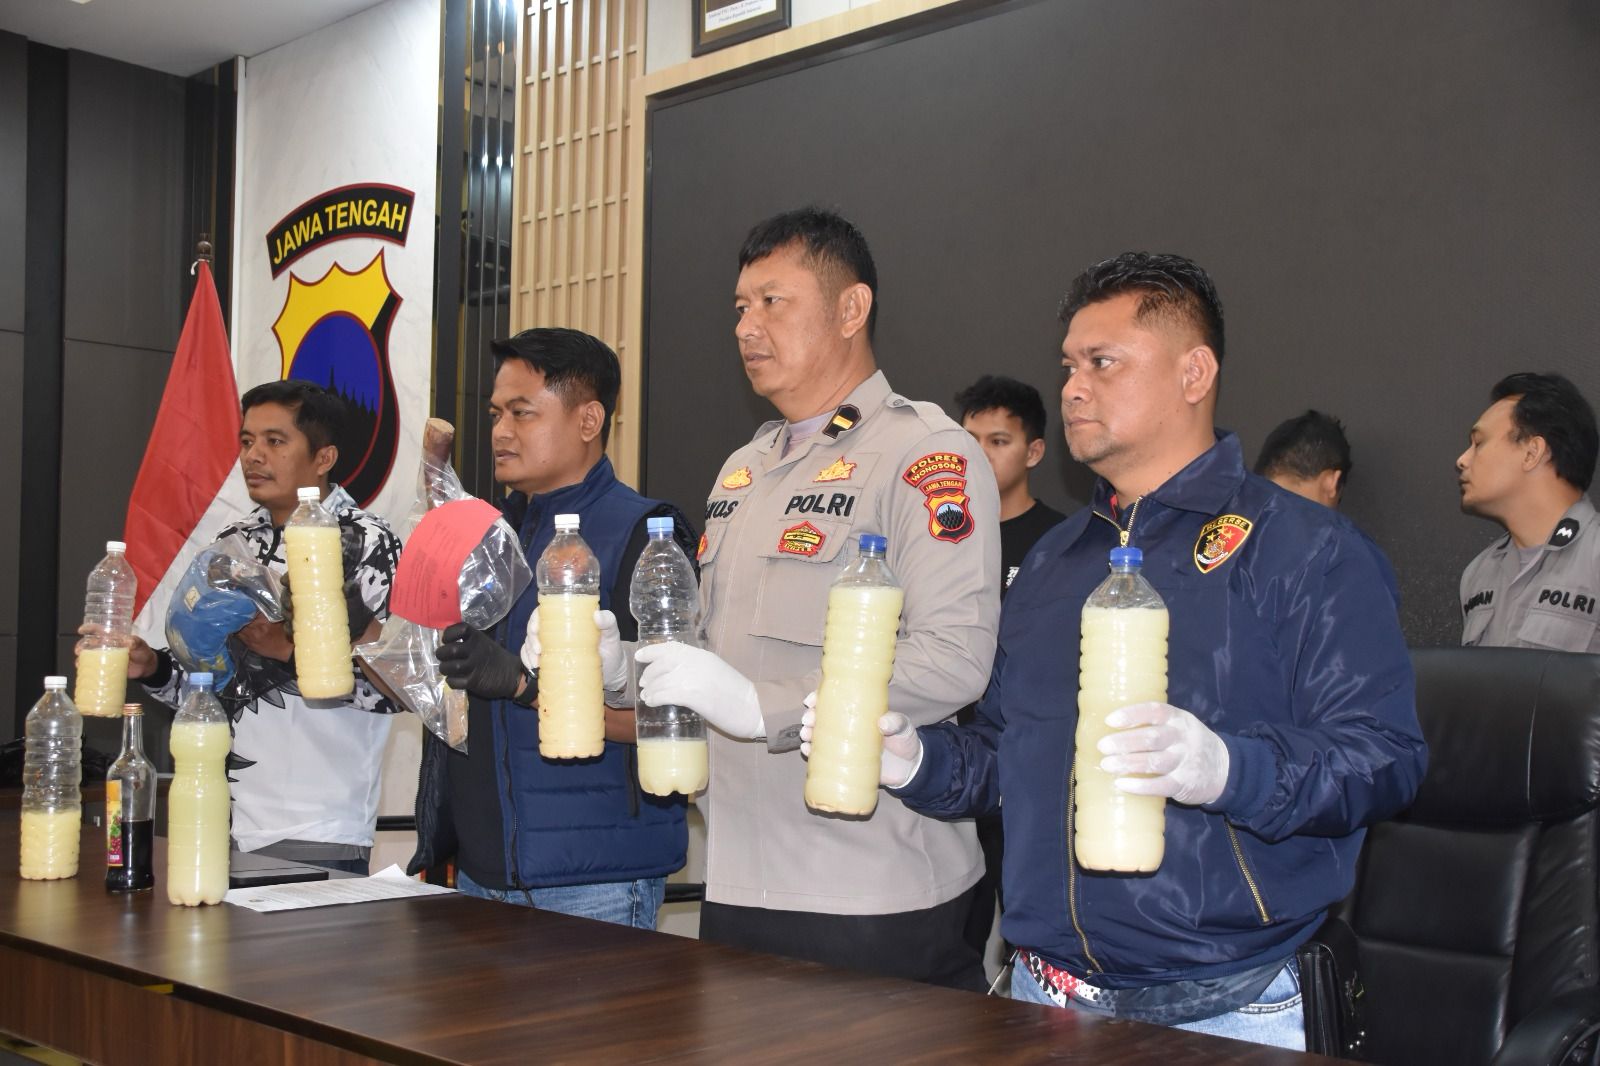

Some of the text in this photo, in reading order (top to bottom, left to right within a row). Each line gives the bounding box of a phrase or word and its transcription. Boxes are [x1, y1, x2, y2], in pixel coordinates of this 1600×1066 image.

[273, 199, 407, 265] JAWA TENGAH
[911, 455, 959, 474] POLRES
[911, 462, 962, 481] WONOSOBO
[784, 493, 856, 517] POLRI
[1538, 589, 1596, 614] POLRI
